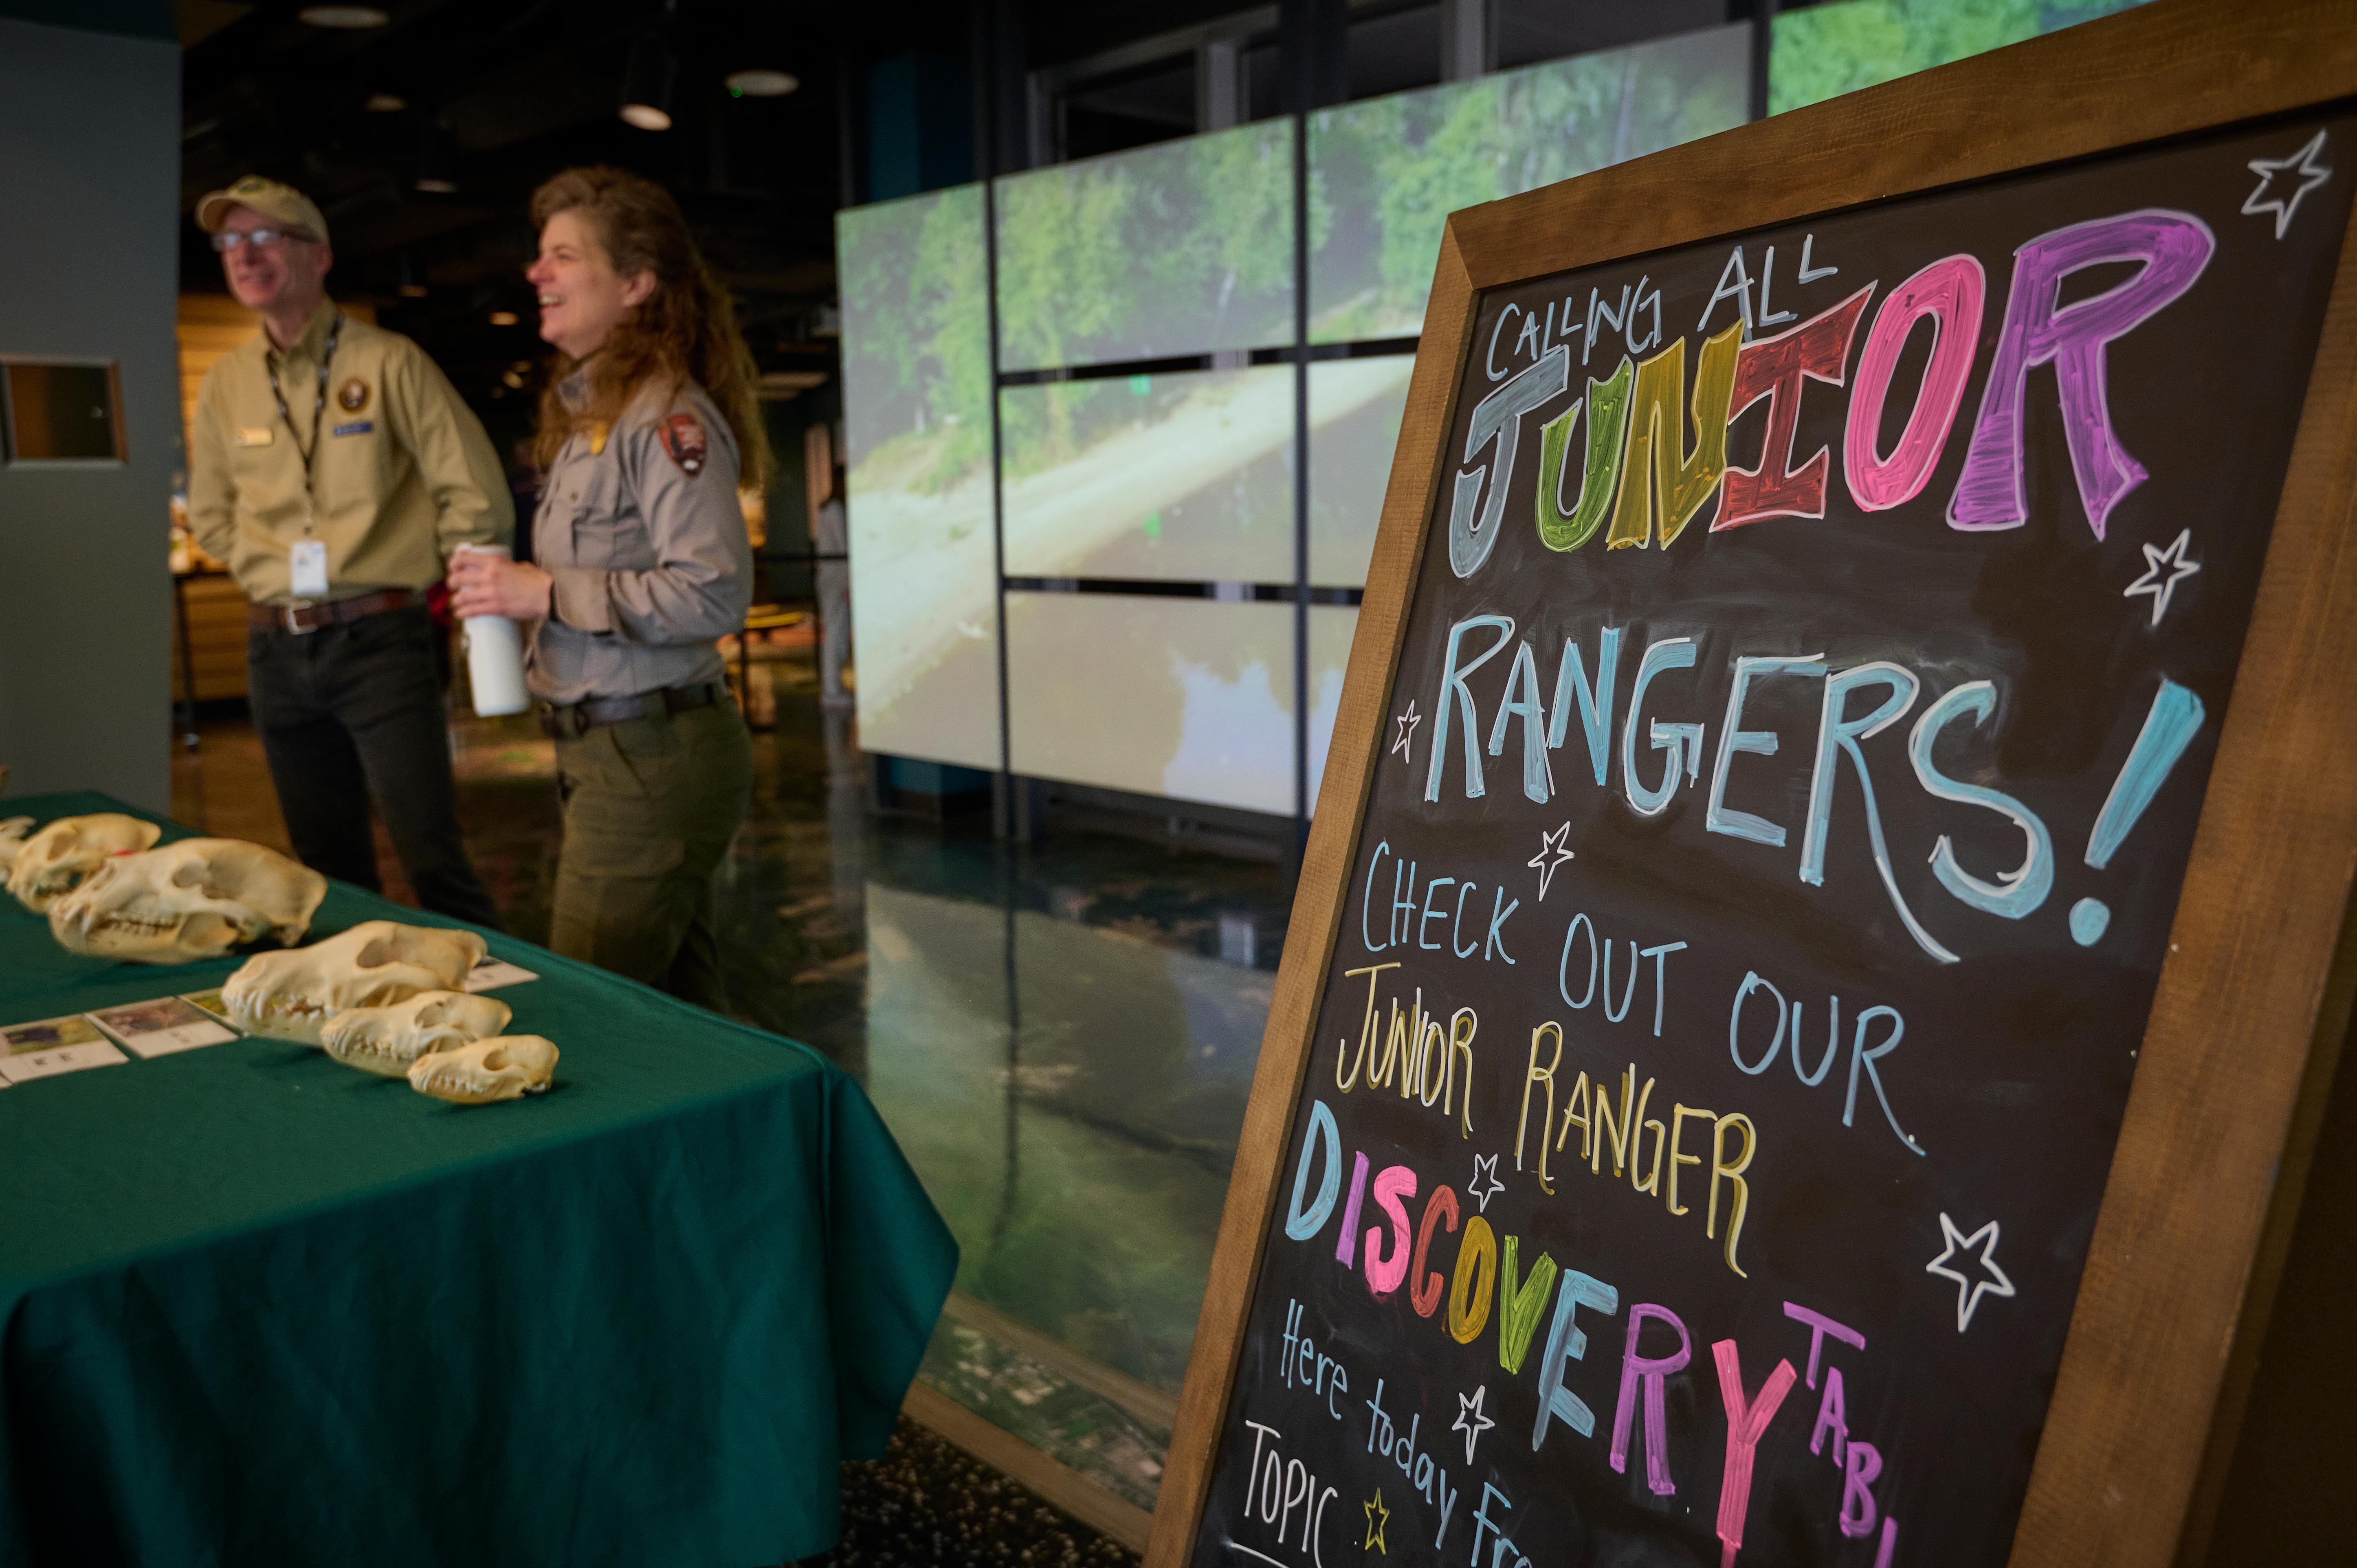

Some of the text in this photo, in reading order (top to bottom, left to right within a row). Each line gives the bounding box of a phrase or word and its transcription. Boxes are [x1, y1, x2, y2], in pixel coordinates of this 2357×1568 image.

[1448, 209, 2216, 578] JUNIOR
[1486, 233, 1838, 381] CALLING ALL
[1425, 615, 2205, 963] RANGERS!
[1336, 962, 1757, 1278] JUNIOR RANGER
[1362, 841, 1926, 1156] CHECK OUT OUR
[1281, 1299, 1347, 1419] Here
[1366, 1379, 1457, 1549] today
[1285, 1099, 1797, 1568] DISCOVERY
[1244, 1420, 1337, 1568] TOPIC
